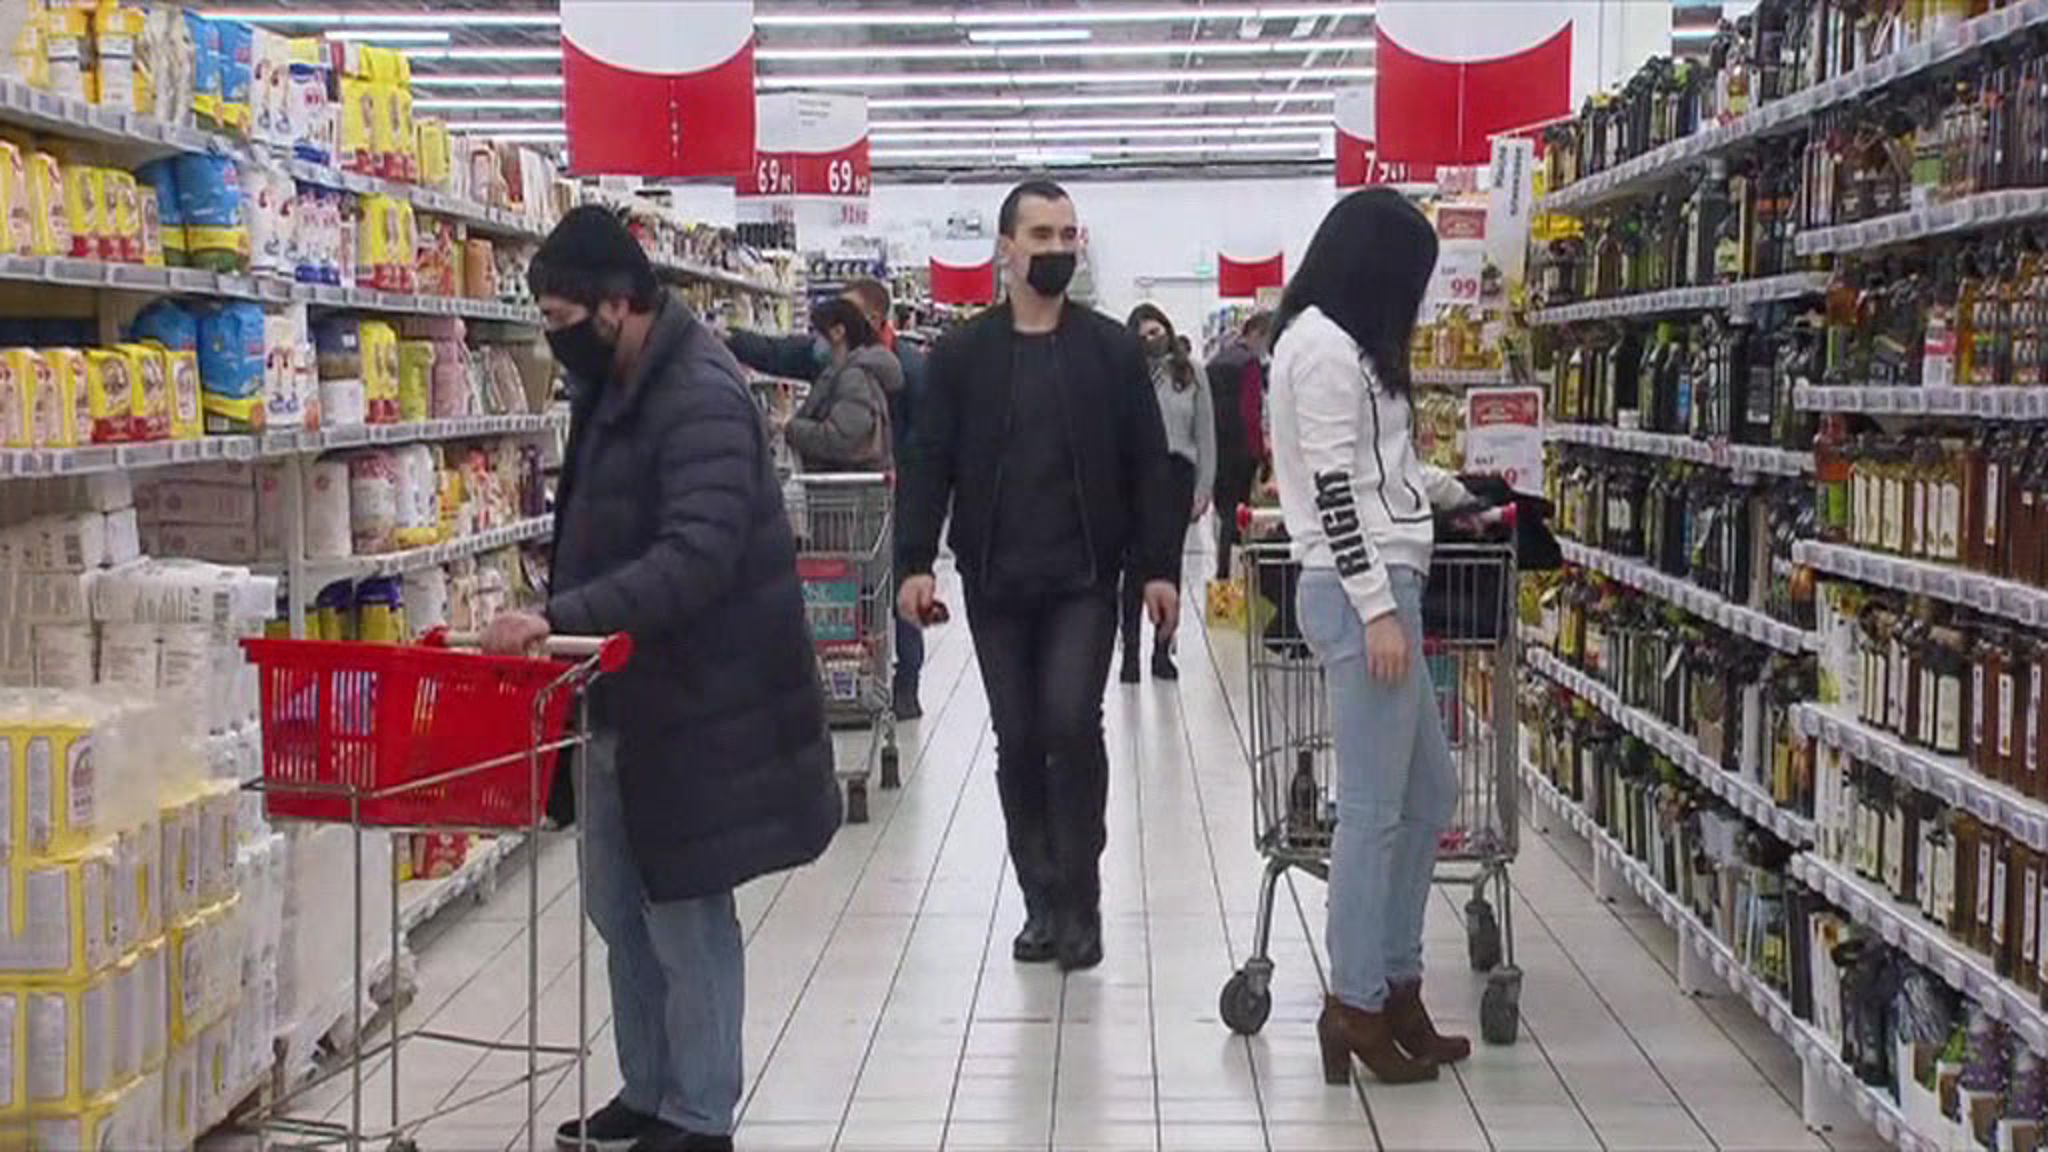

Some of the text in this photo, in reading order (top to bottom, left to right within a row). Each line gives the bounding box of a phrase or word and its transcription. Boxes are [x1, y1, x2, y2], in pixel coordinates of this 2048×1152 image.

[758, 160, 779, 193] 69
[829, 160, 851, 193] 69
[1452, 278, 1477, 298] 99
[1314, 471, 1372, 578] RIGHT
